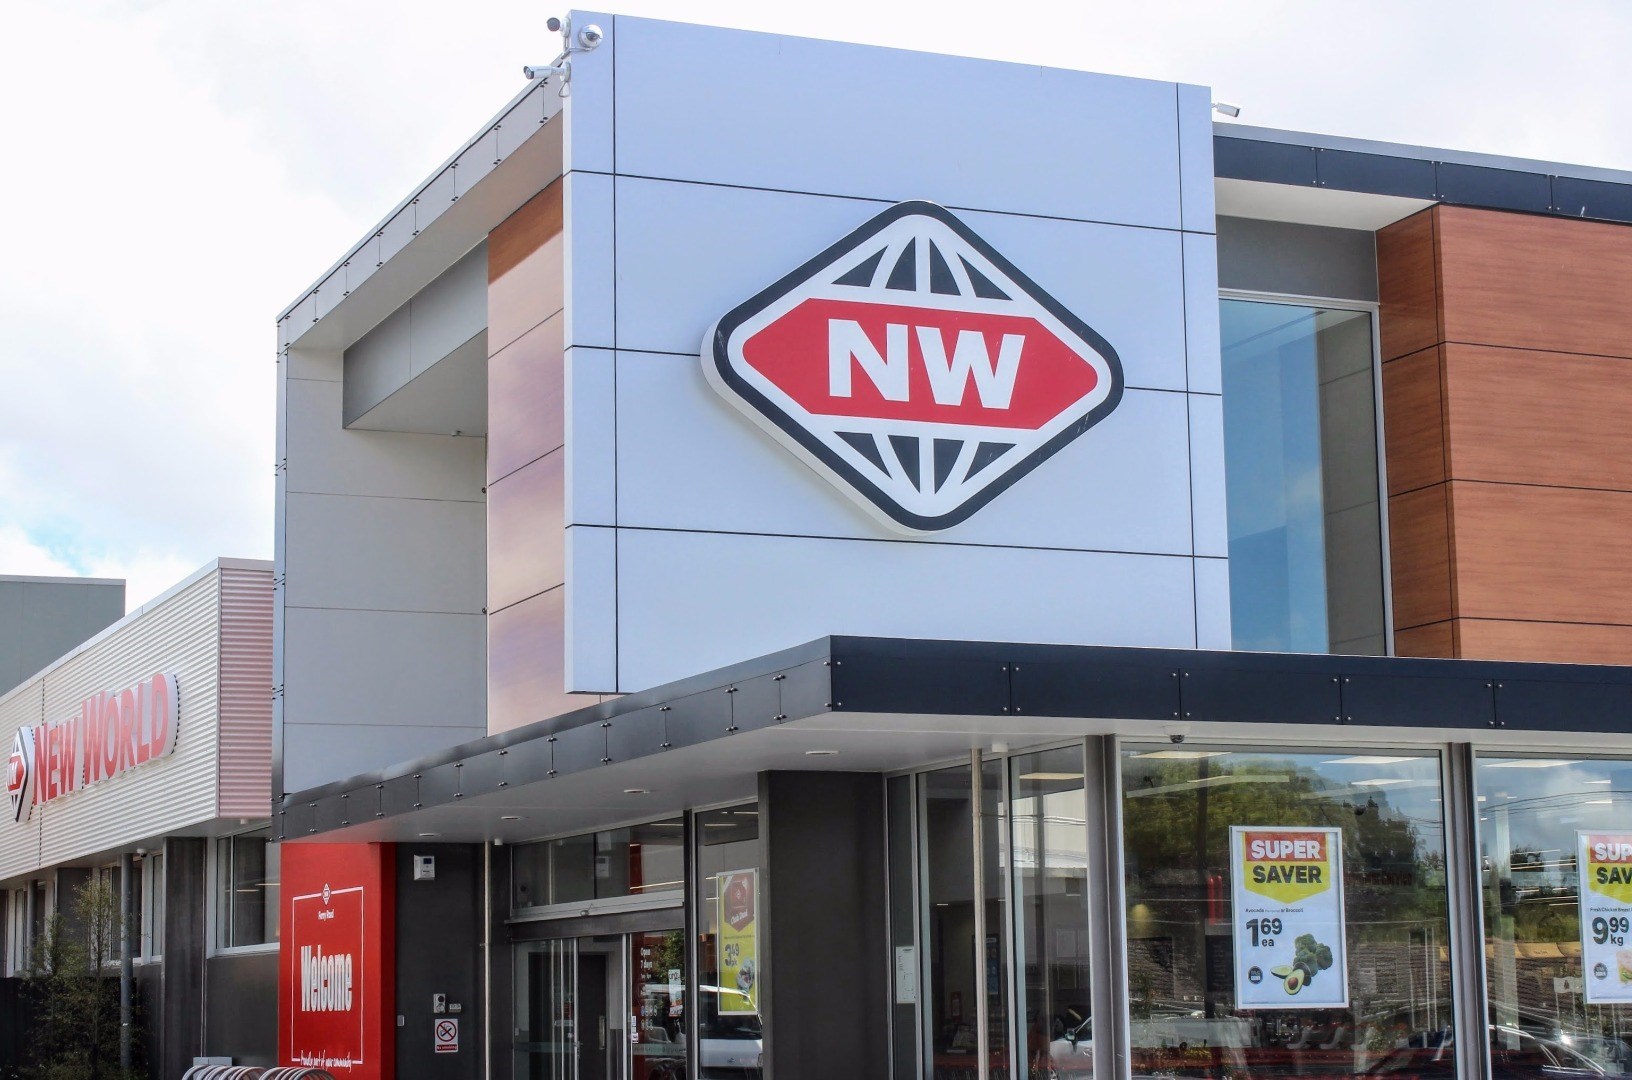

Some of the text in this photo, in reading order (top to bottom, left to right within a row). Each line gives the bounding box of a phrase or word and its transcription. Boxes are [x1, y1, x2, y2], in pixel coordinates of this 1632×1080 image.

[828, 319, 1025, 409] NW
[33, 673, 168, 806] NEW WORLD
[1251, 840, 1320, 859] SUPER
[1253, 865, 1322, 884] SAVER
[1261, 938, 1275, 947] ea
[1610, 934, 1624, 947] kg
[301, 944, 352, 1012] Welcome
